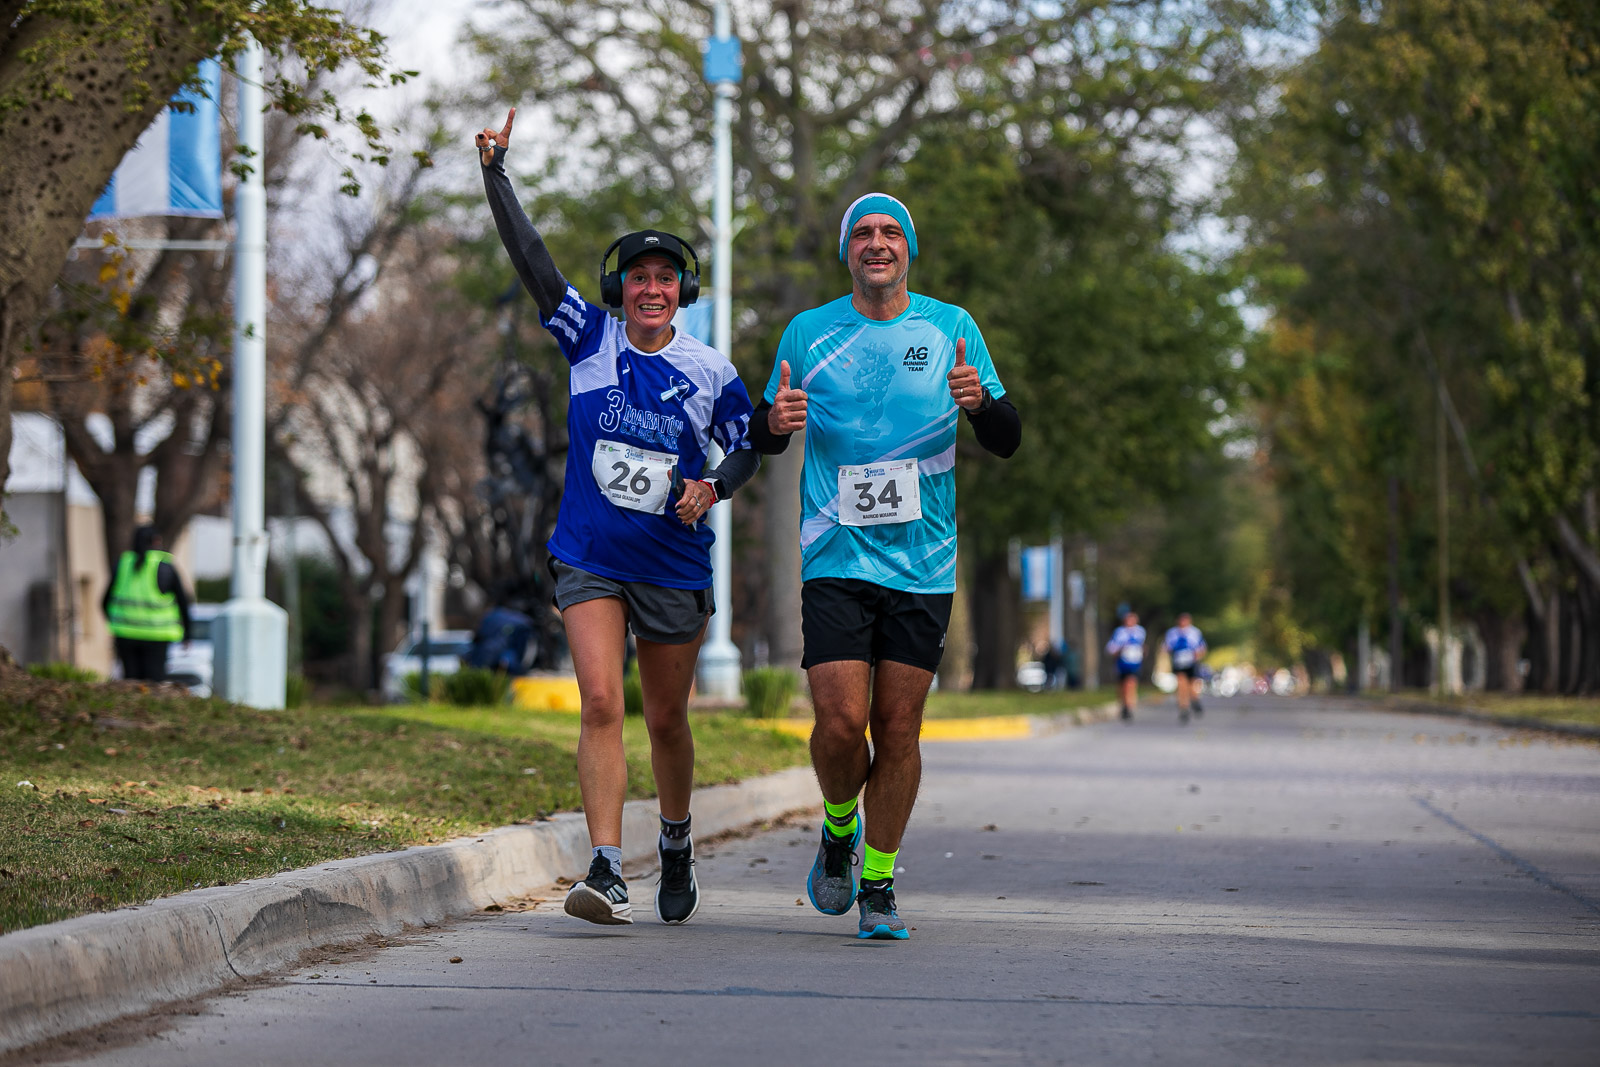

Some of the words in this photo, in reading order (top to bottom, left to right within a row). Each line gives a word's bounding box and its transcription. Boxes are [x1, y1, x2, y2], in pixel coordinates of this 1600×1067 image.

[904, 346, 928, 360] AG
[599, 389, 625, 432] 3
[623, 405, 684, 437] MARATÓN
[625, 449, 630, 459] 3
[608, 461, 651, 495] 26
[864, 468, 869, 478] 3
[854, 479, 902, 512] 34
